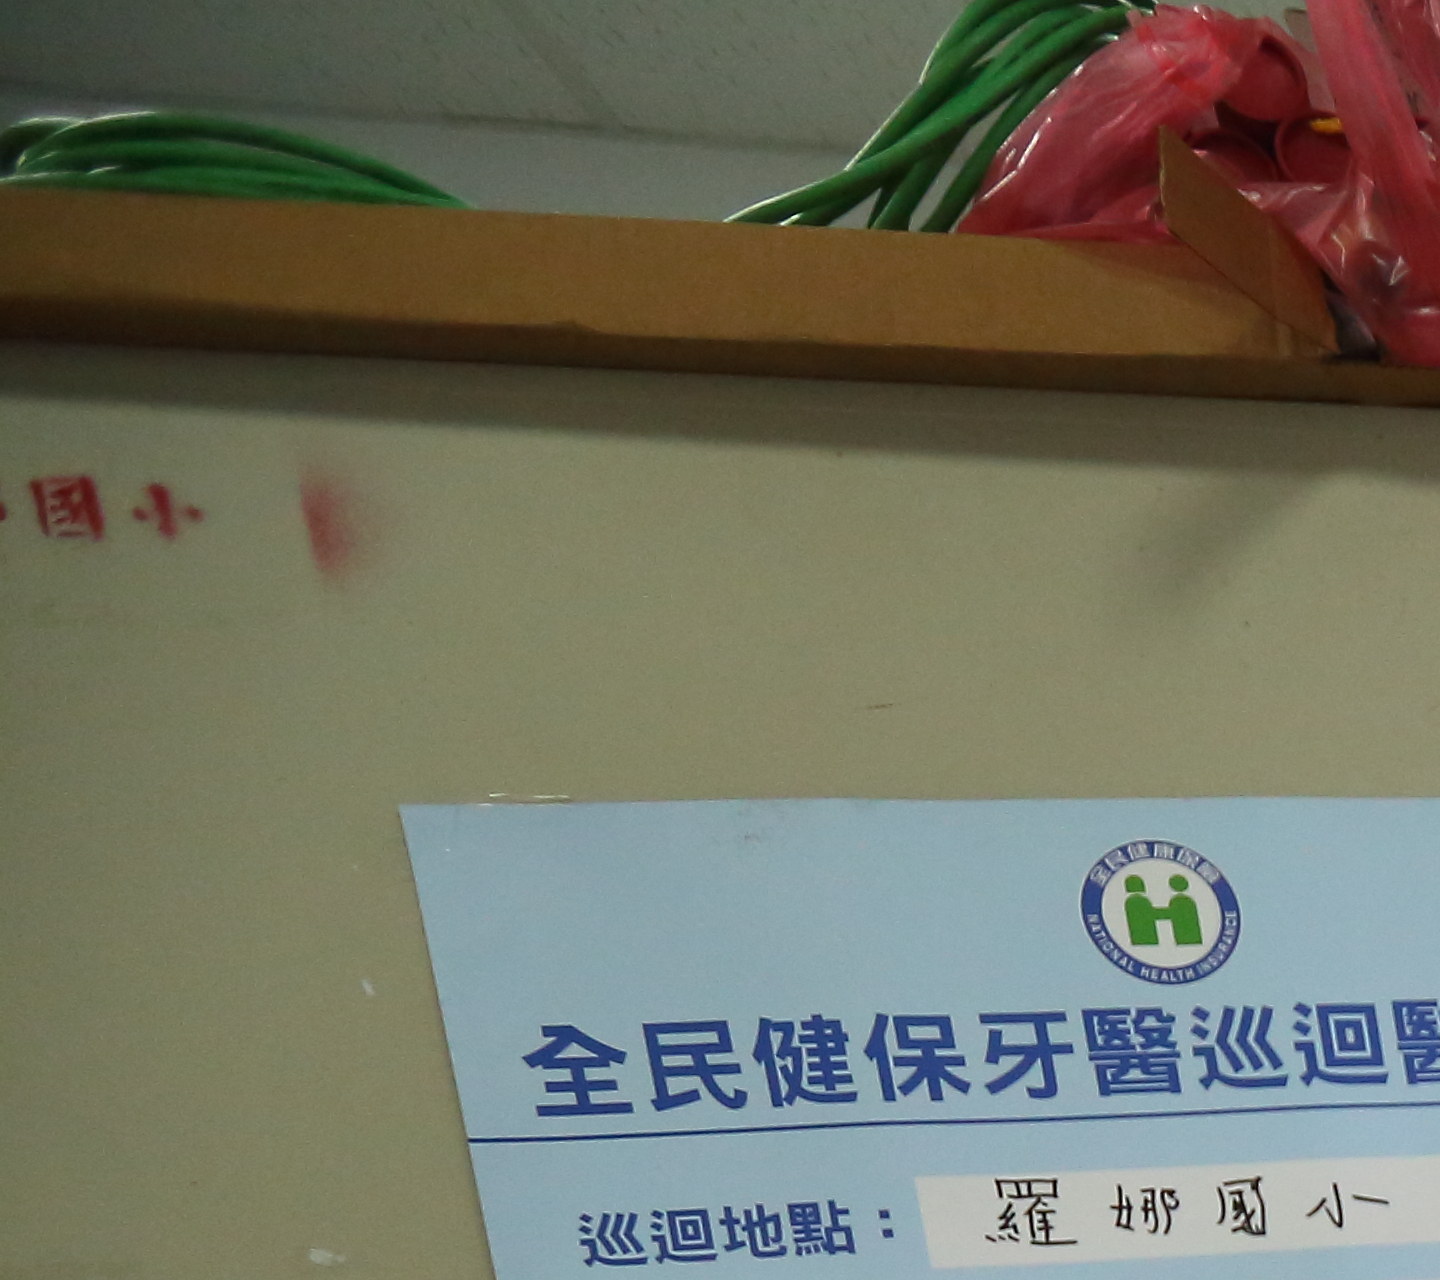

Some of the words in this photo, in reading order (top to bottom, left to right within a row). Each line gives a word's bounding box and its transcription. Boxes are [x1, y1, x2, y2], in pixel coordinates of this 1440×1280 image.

[0, 474, 204, 541] 國小
[1140, 966, 1196, 983] HEALTH
[578, 1199, 895, 1267] 巡迴地點：
